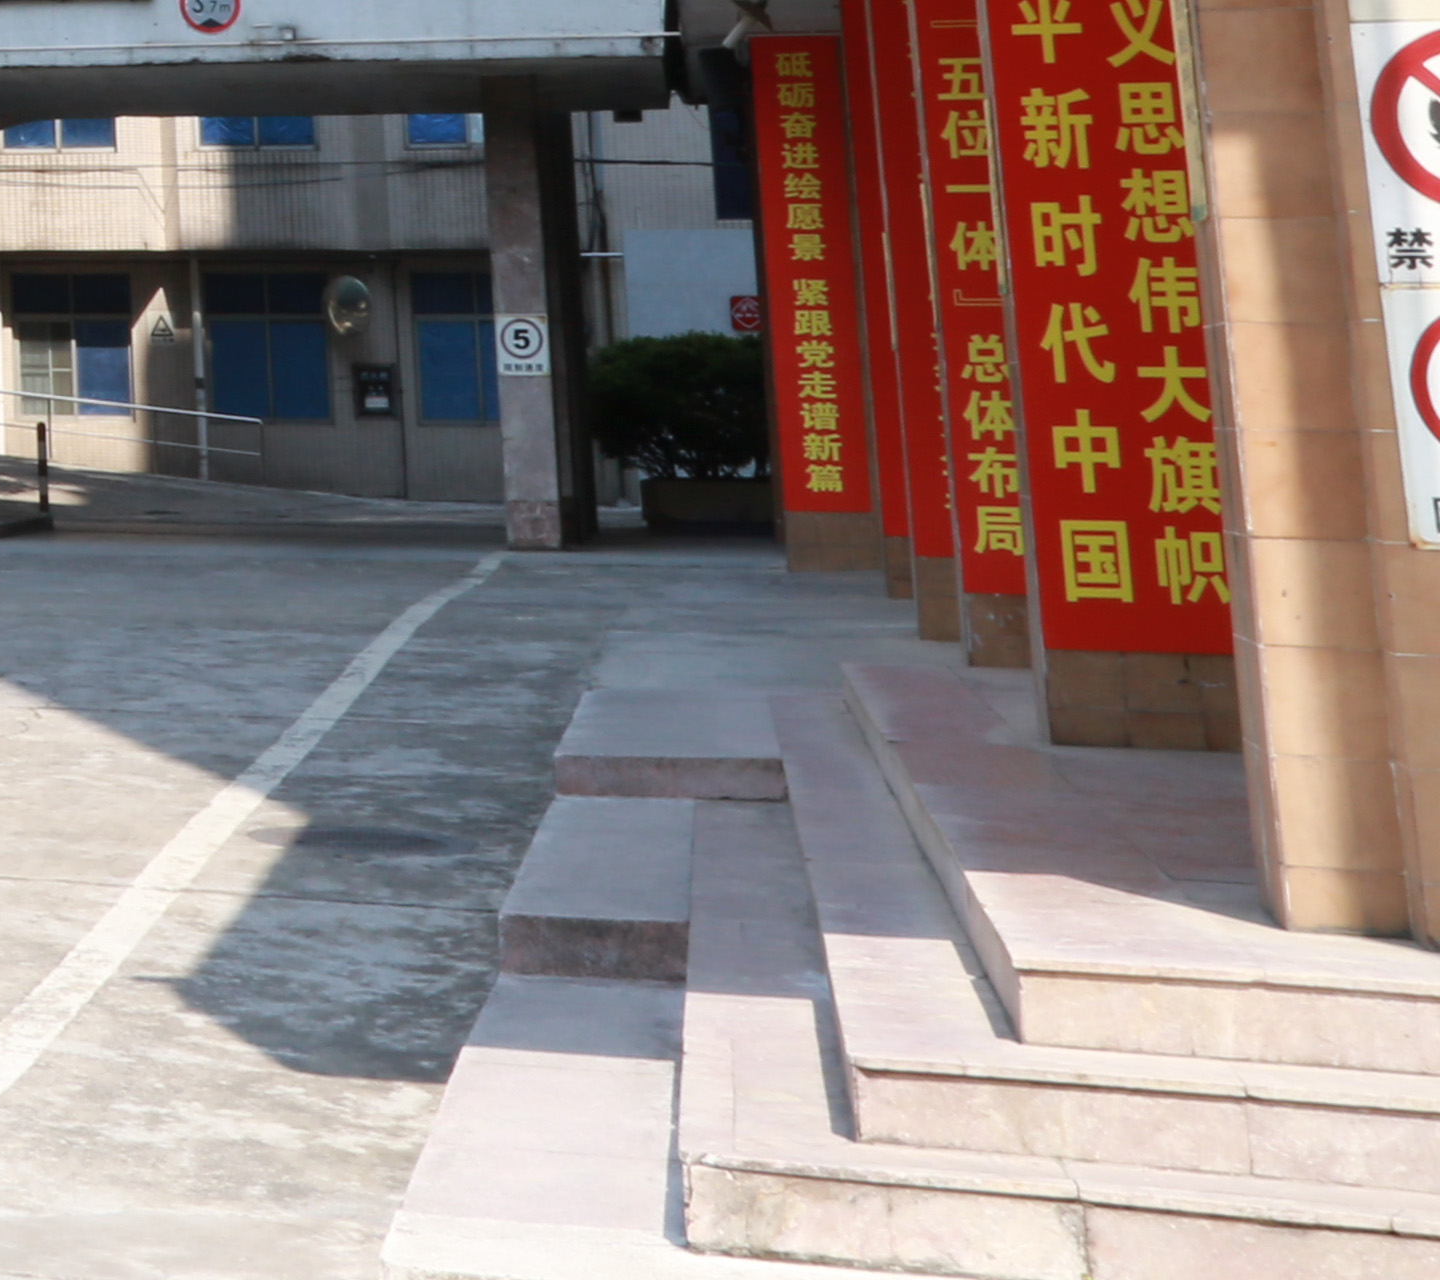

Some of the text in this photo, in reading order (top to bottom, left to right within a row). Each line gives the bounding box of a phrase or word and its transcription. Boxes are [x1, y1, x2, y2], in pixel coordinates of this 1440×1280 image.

[1385, 226, 1434, 270] 禁
[774, 51, 844, 494] 砥砺奋进绘愿景 紧跟党走谱新篇
[512, 329, 531, 350] 5
